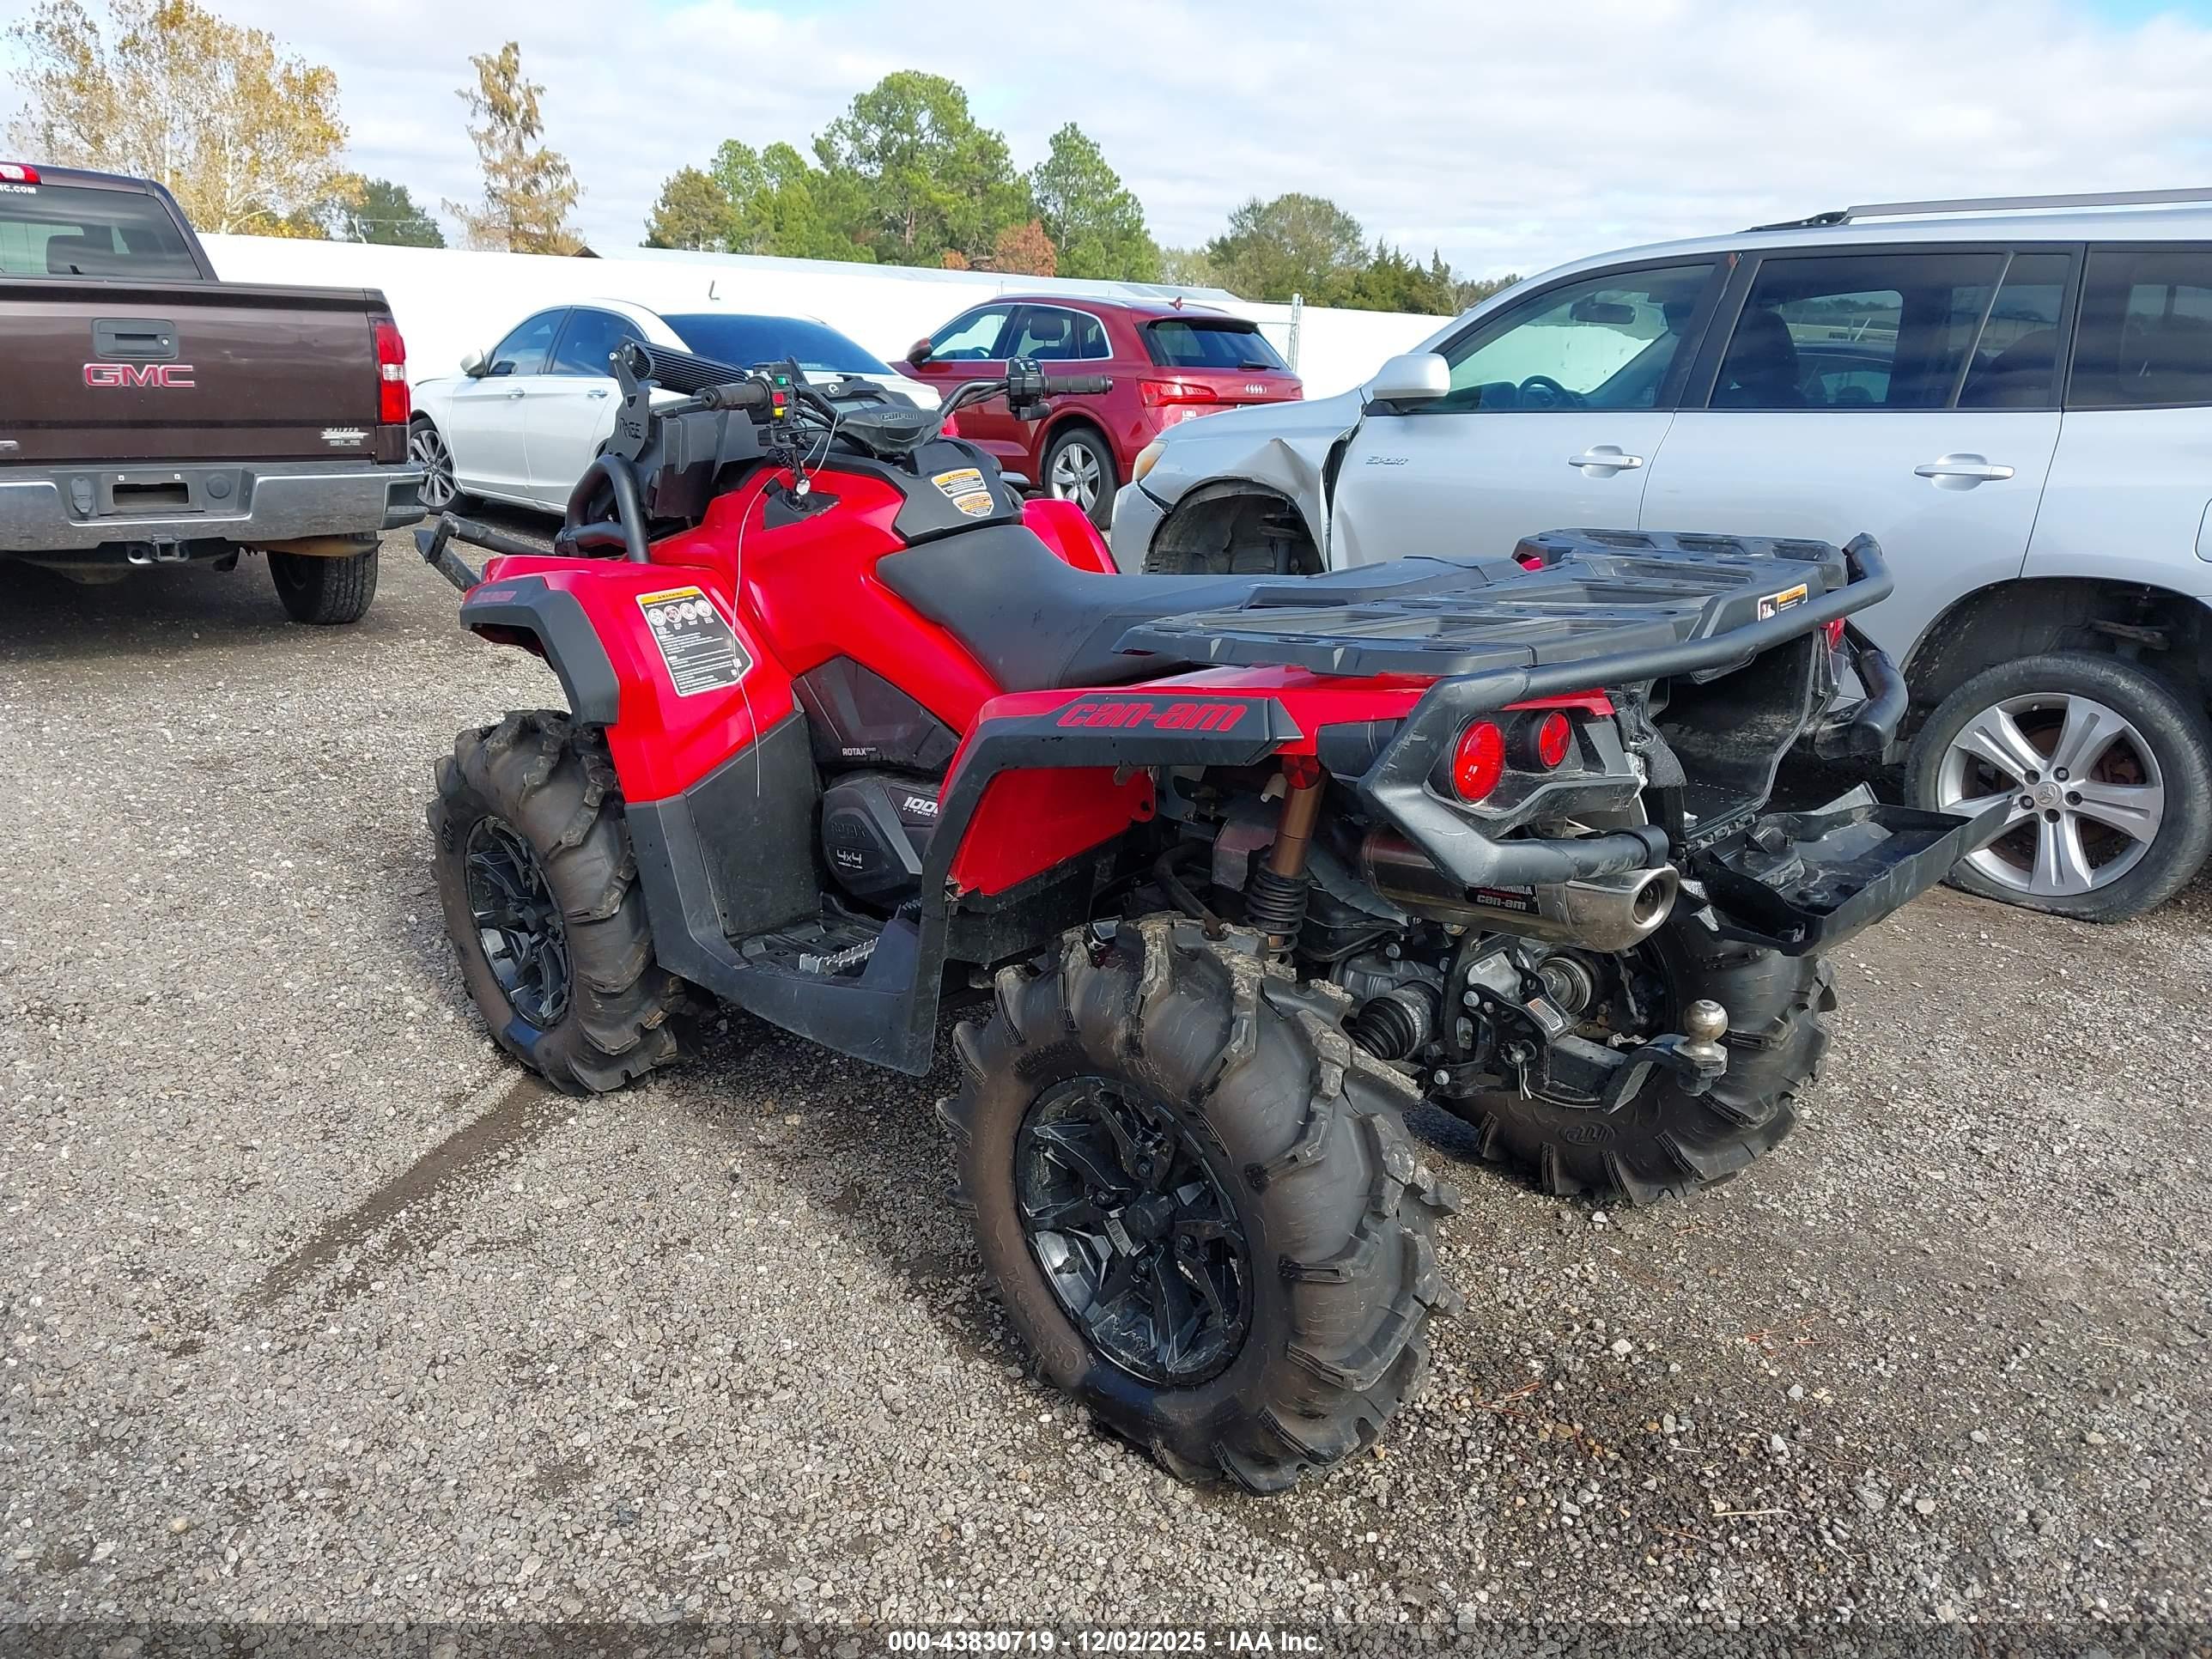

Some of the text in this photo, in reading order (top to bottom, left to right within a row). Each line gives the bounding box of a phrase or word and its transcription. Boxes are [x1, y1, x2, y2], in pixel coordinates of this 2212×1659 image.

[83, 363, 195, 387] GMC
[1056, 702, 1248, 732] can-am
[842, 747, 866, 756] ROTAX
[836, 849, 862, 865] 4x4
[1477, 895, 1527, 910] can-am
